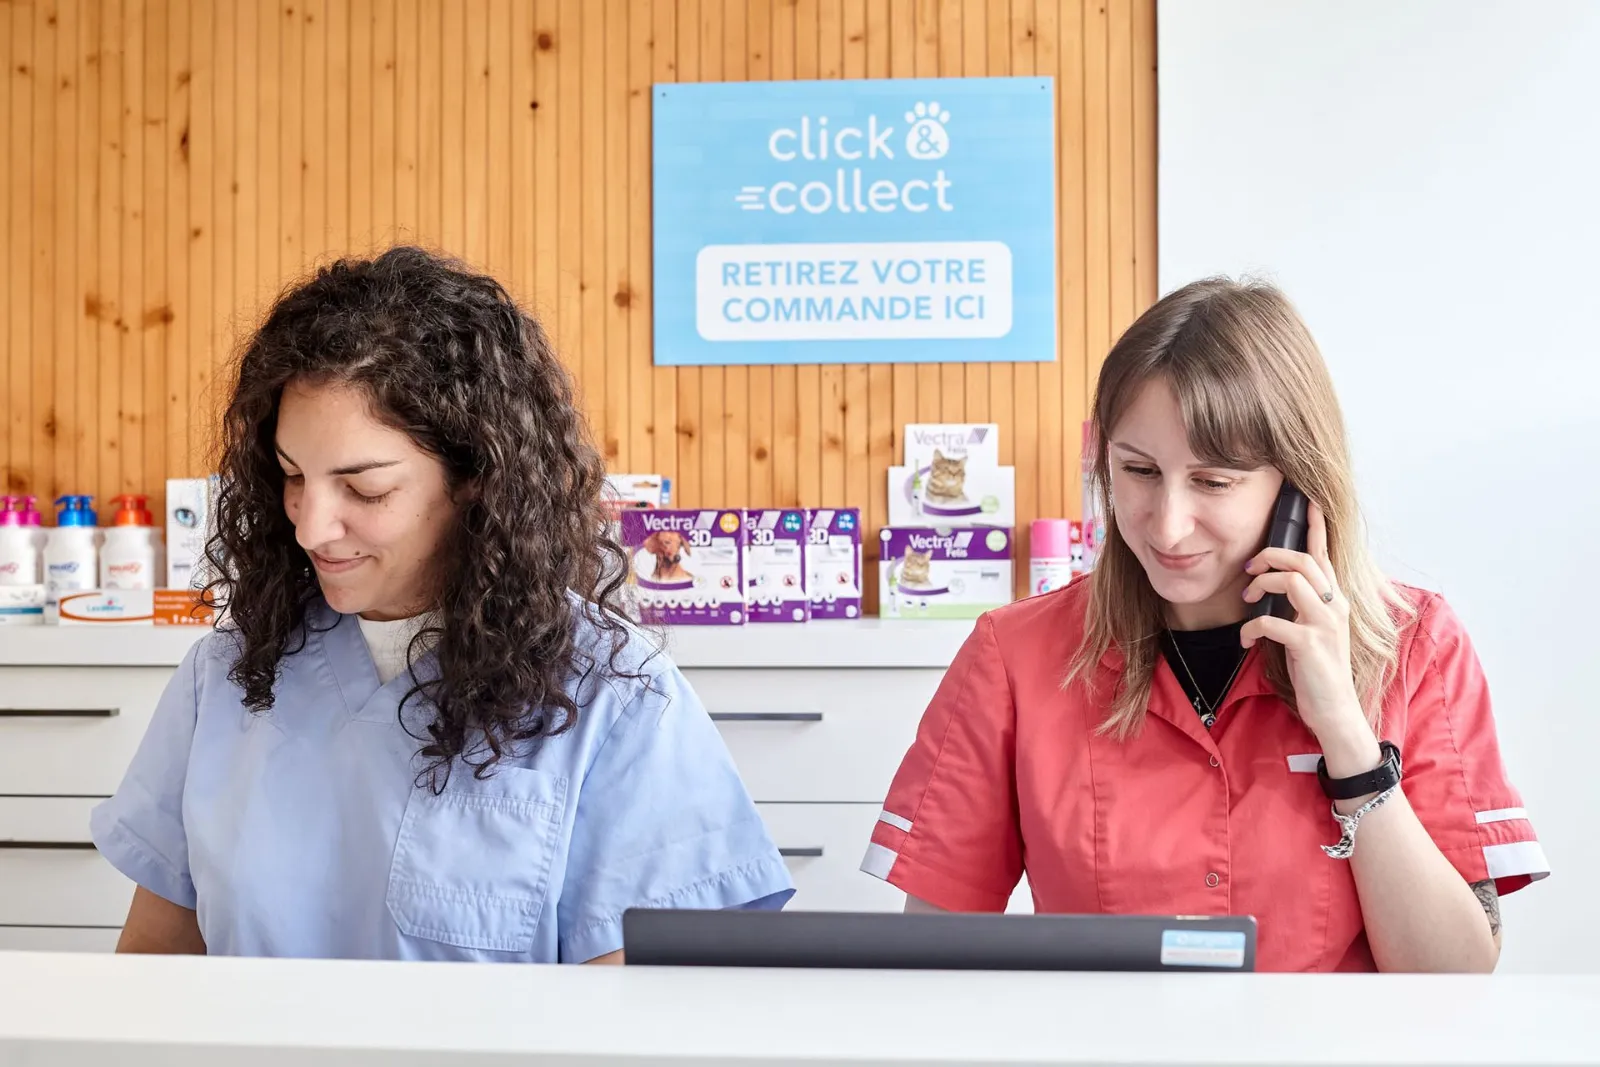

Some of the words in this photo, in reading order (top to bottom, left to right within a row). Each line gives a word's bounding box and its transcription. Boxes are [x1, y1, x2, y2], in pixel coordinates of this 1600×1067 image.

[768, 113, 895, 161] click
[768, 167, 954, 214] collect
[722, 260, 860, 287] RETIREZ
[872, 259, 986, 285] VOTRE
[722, 296, 932, 323] COMMANDE
[945, 295, 985, 320] ICI
[914, 430, 965, 446] Vectra
[642, 513, 695, 531] Vectra
[688, 529, 712, 547] 3D
[752, 528, 775, 546] 3D
[809, 528, 828, 545] 3D
[909, 533, 953, 549] Vectra
